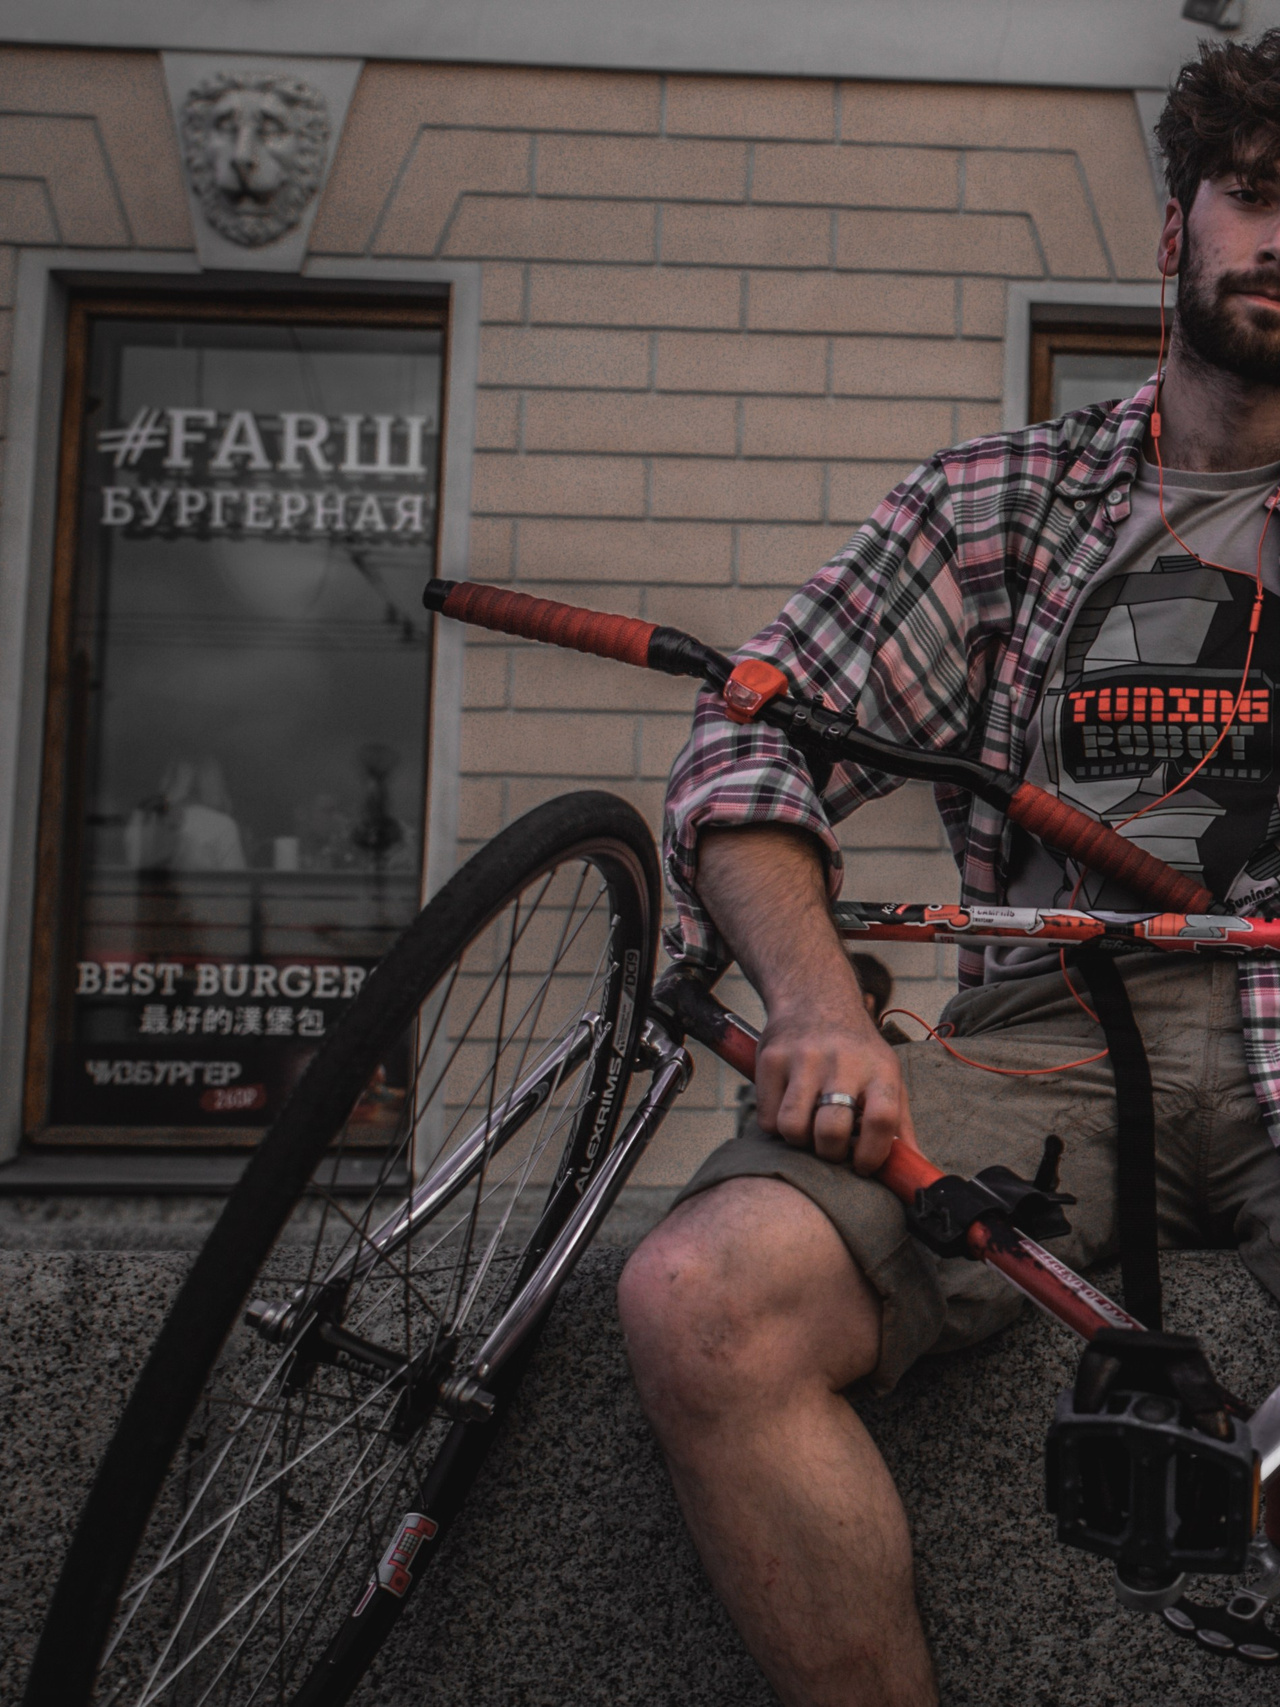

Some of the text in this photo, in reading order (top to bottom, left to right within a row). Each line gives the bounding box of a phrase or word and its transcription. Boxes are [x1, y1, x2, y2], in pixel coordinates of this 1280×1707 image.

[97, 406, 427, 474] #FARШ
[101, 486, 424, 532] БУРГЕРНАЯ
[1067, 687, 1270, 723] TUNING
[1082, 725, 1254, 760] ROBOT
[75, 962, 368, 999] BEST BURGER
[575, 1057, 622, 1194] ALEXRIMS
